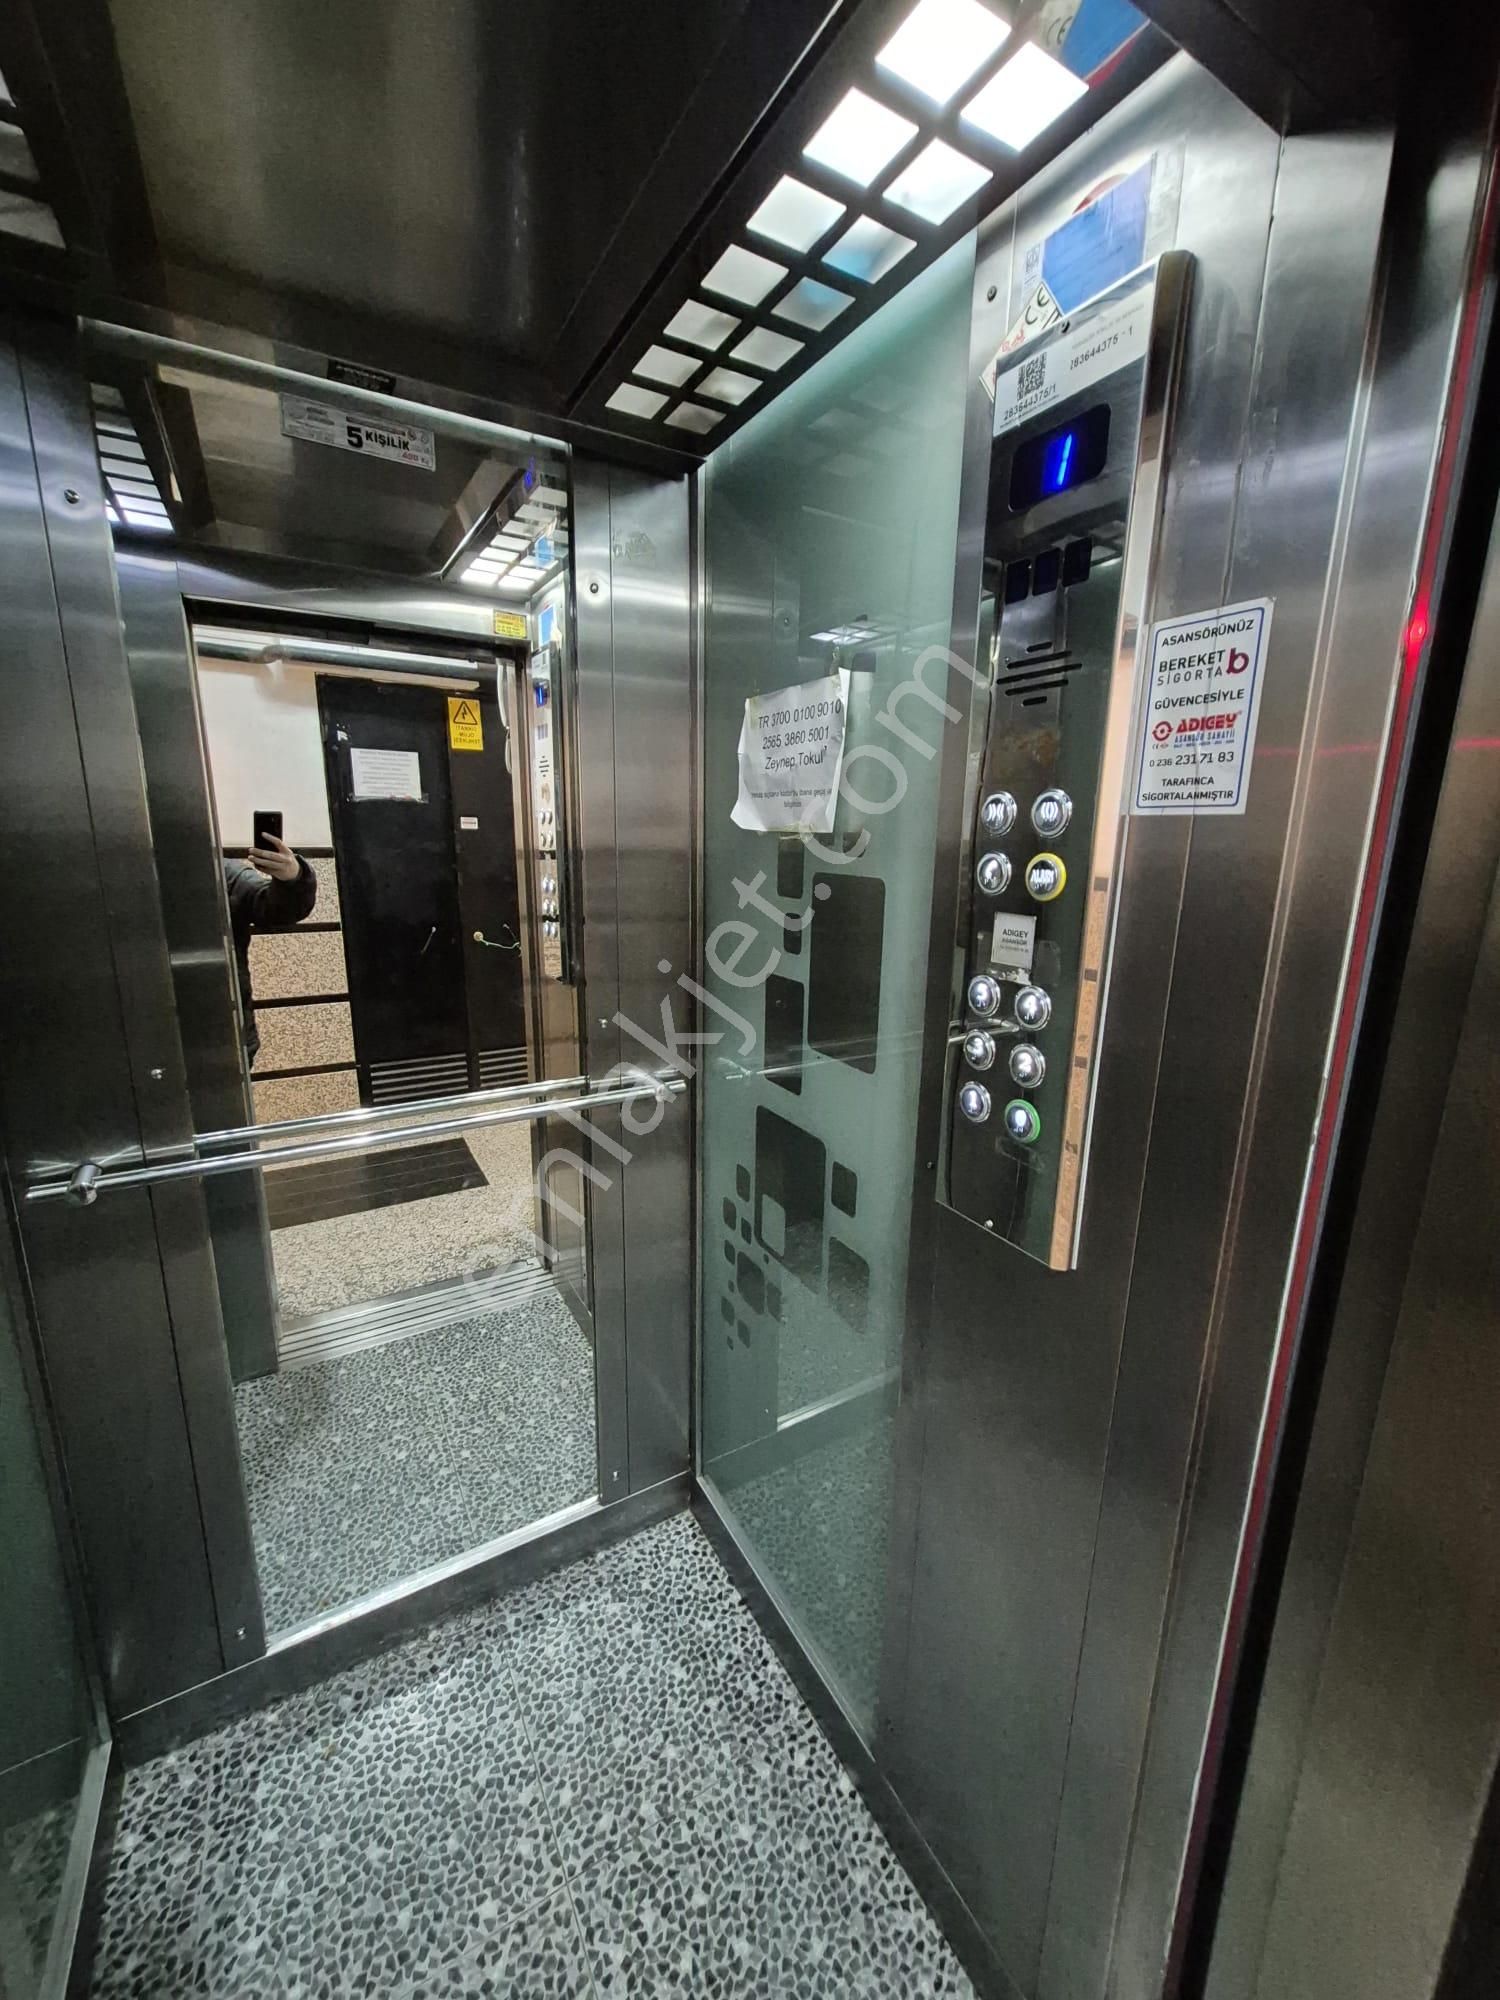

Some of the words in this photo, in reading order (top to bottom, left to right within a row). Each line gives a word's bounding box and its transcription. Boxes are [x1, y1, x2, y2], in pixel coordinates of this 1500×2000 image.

[346, 425, 363, 448] 5
[1161, 618, 1255, 647] ASANSÖRÜNÜZ
[1159, 649, 1226, 673] BEREKET
[1157, 665, 1223, 686] SİGORTA
[1154, 688, 1245, 710] GÜVENCESİYLE
[758, 716, 769, 728] TR
[771, 710, 791, 727] 3700
[793, 705, 816, 722] 0100
[817, 698, 842, 717] 9010
[762, 735, 782, 750] 2565
[784, 730, 806, 747] 3860
[808, 726, 830, 743] 5001
[1149, 759, 1155, 767] 0
[1156, 758, 1173, 767] 236
[1217, 751, 1235, 763] 83
[1161, 776, 1215, 787] TARAFINCA
[1142, 790, 1234, 802] SİGORTALANMIŞTIR
[1017, 1052, 1031, 1070] 2
[969, 1089, 978, 1108] 1
